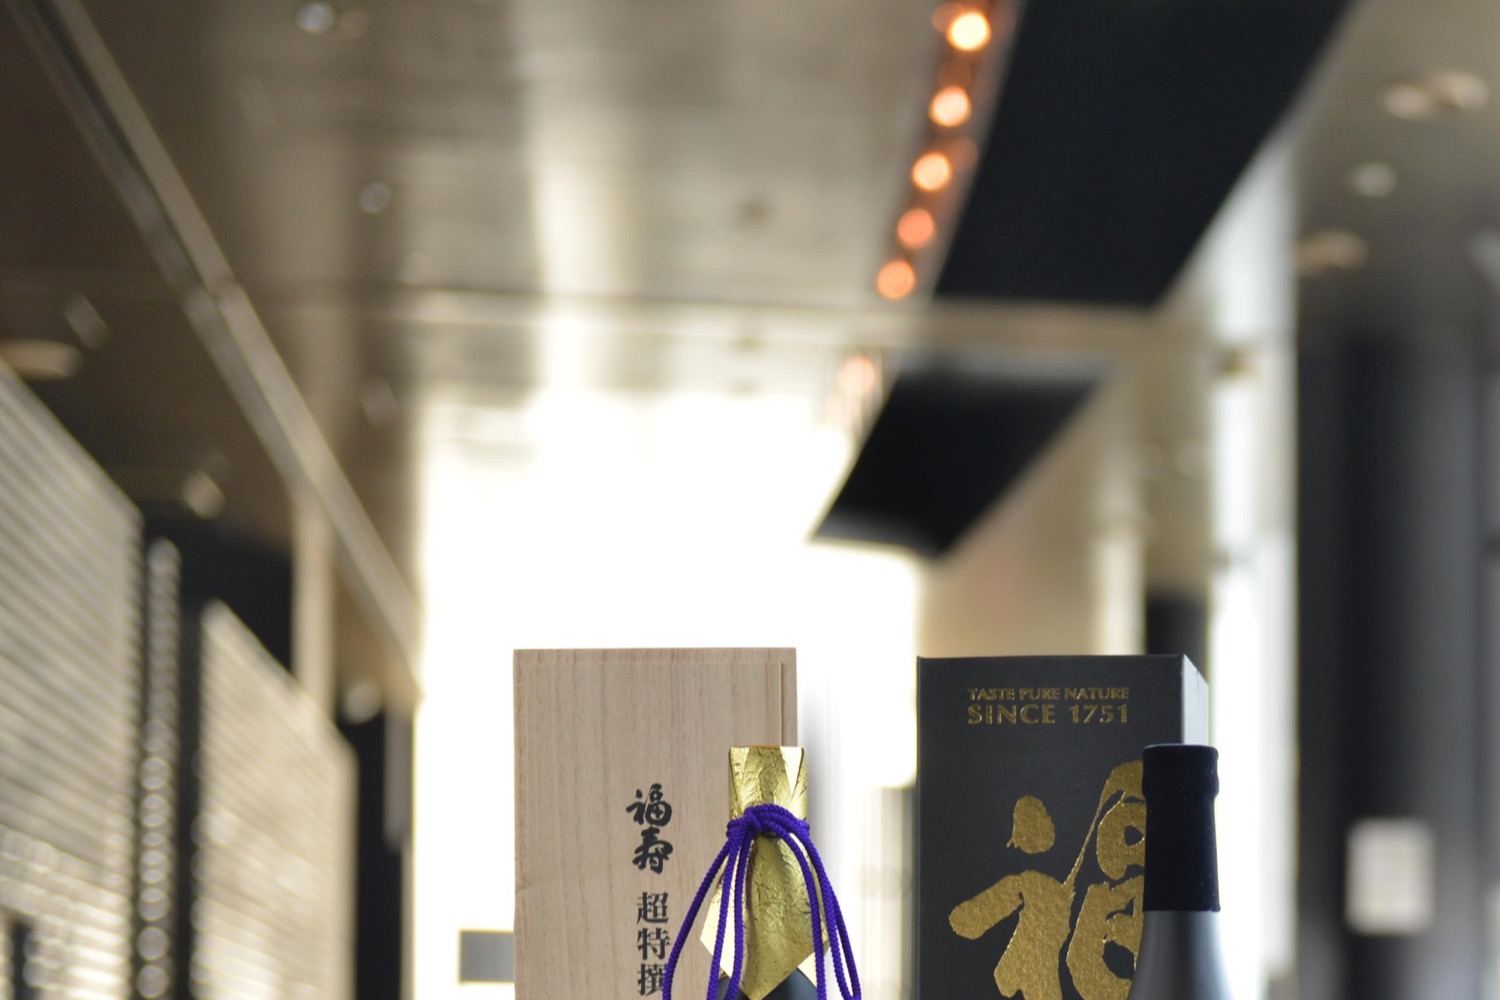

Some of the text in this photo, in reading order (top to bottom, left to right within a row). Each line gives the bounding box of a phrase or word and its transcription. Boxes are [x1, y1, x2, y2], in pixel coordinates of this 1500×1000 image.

[968, 687, 1130, 701] TASTE PURE NATURE
[967, 703, 1128, 725] SINCE 1751
[626, 783, 674, 875] 福寿
